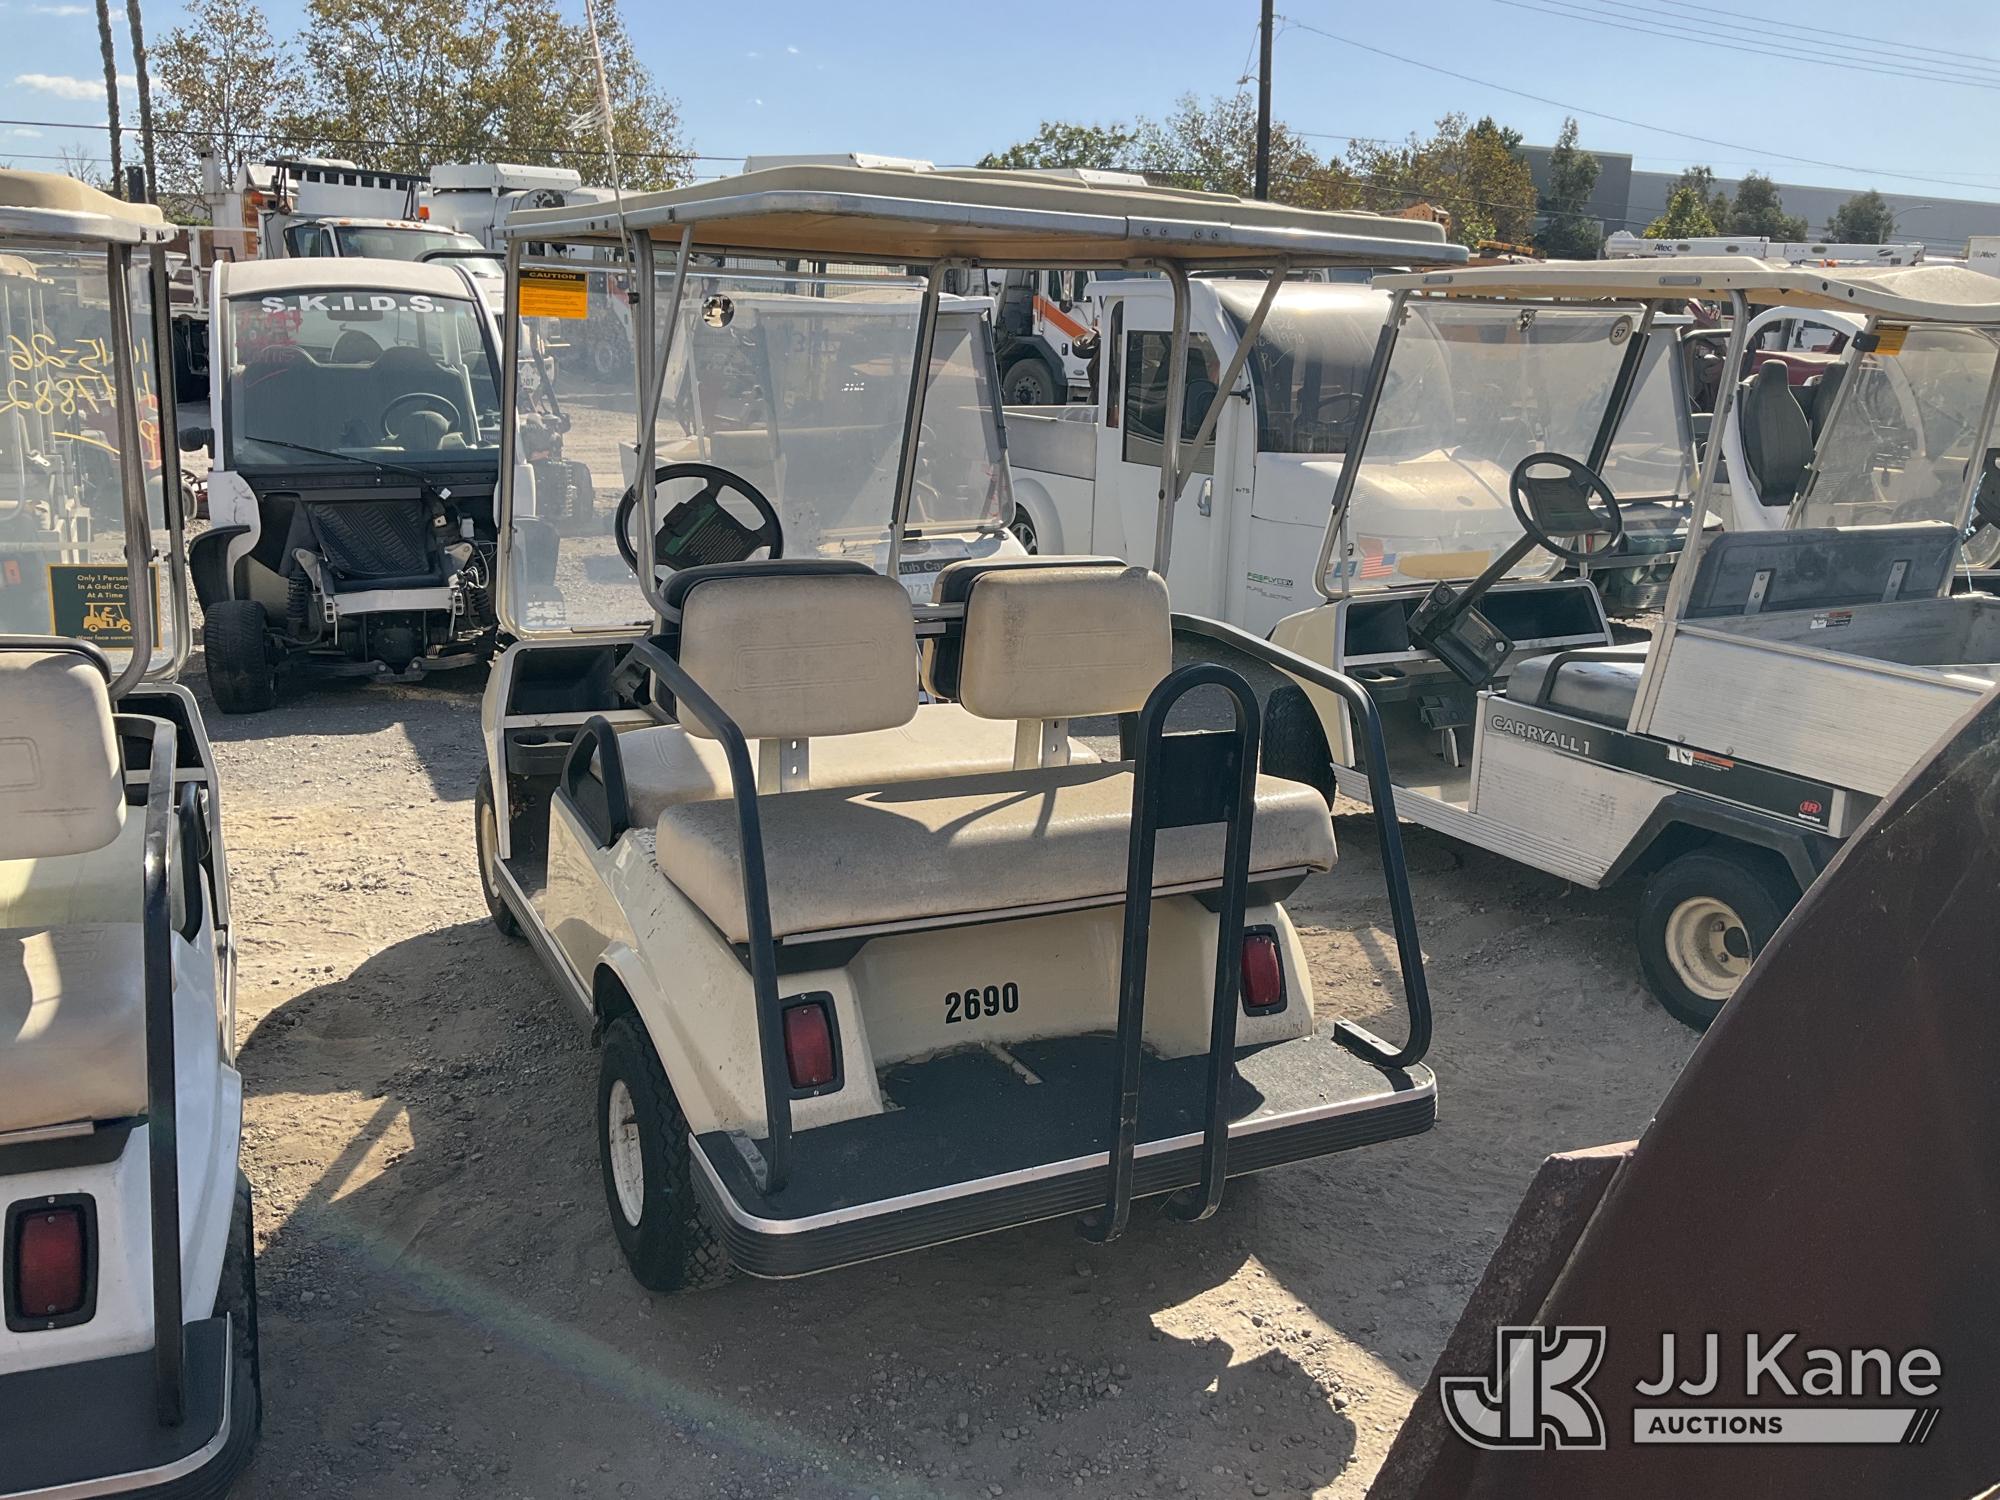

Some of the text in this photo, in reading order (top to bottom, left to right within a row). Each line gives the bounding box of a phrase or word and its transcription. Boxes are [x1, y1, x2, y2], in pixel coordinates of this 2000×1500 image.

[1655, 243, 1672, 251] Altec
[529, 272, 577, 280] CAUTION
[261, 295, 445, 313] S.K.I.D.S.
[1614, 328, 1626, 338] 57
[899, 561, 946, 574] lub Car
[77, 574, 96, 582] Only
[1491, 715, 1590, 755] CARRYALL 1
[945, 982, 1019, 1024] 2690
